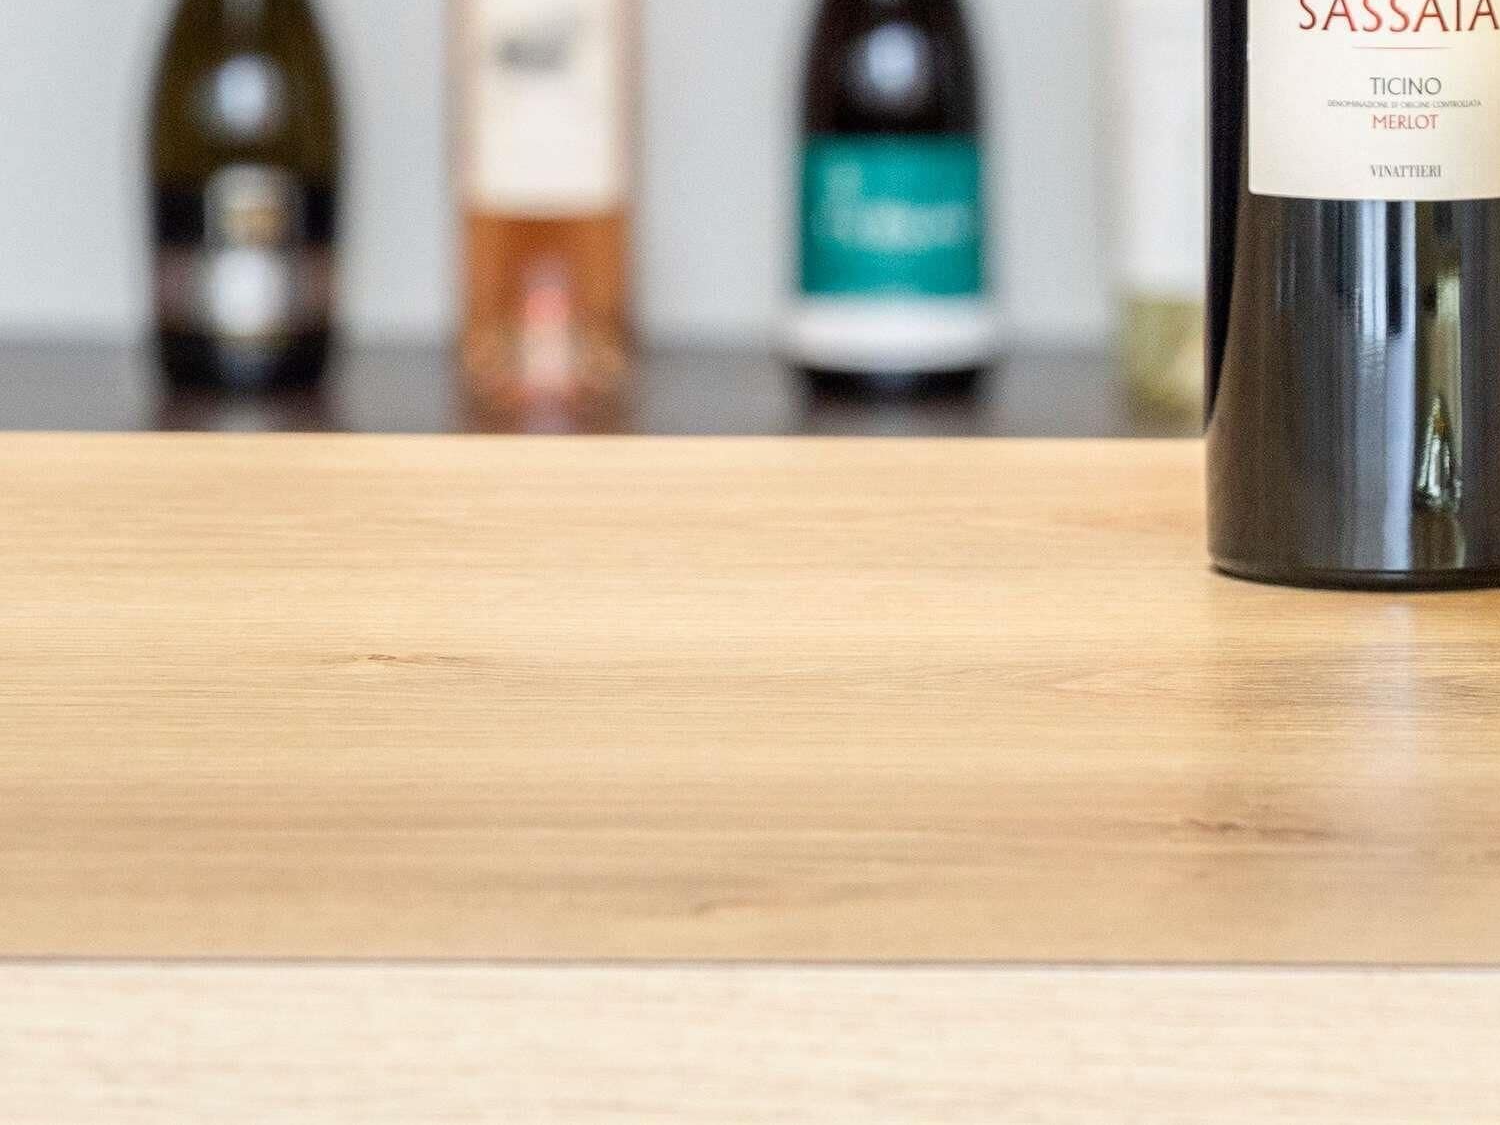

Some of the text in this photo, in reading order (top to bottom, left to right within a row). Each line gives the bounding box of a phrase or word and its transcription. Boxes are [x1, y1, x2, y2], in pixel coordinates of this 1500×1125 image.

[1369, 76, 1443, 96] TICINO
[1372, 114, 1439, 130] MERLOT
[1370, 164, 1442, 178] VINATTIERI
